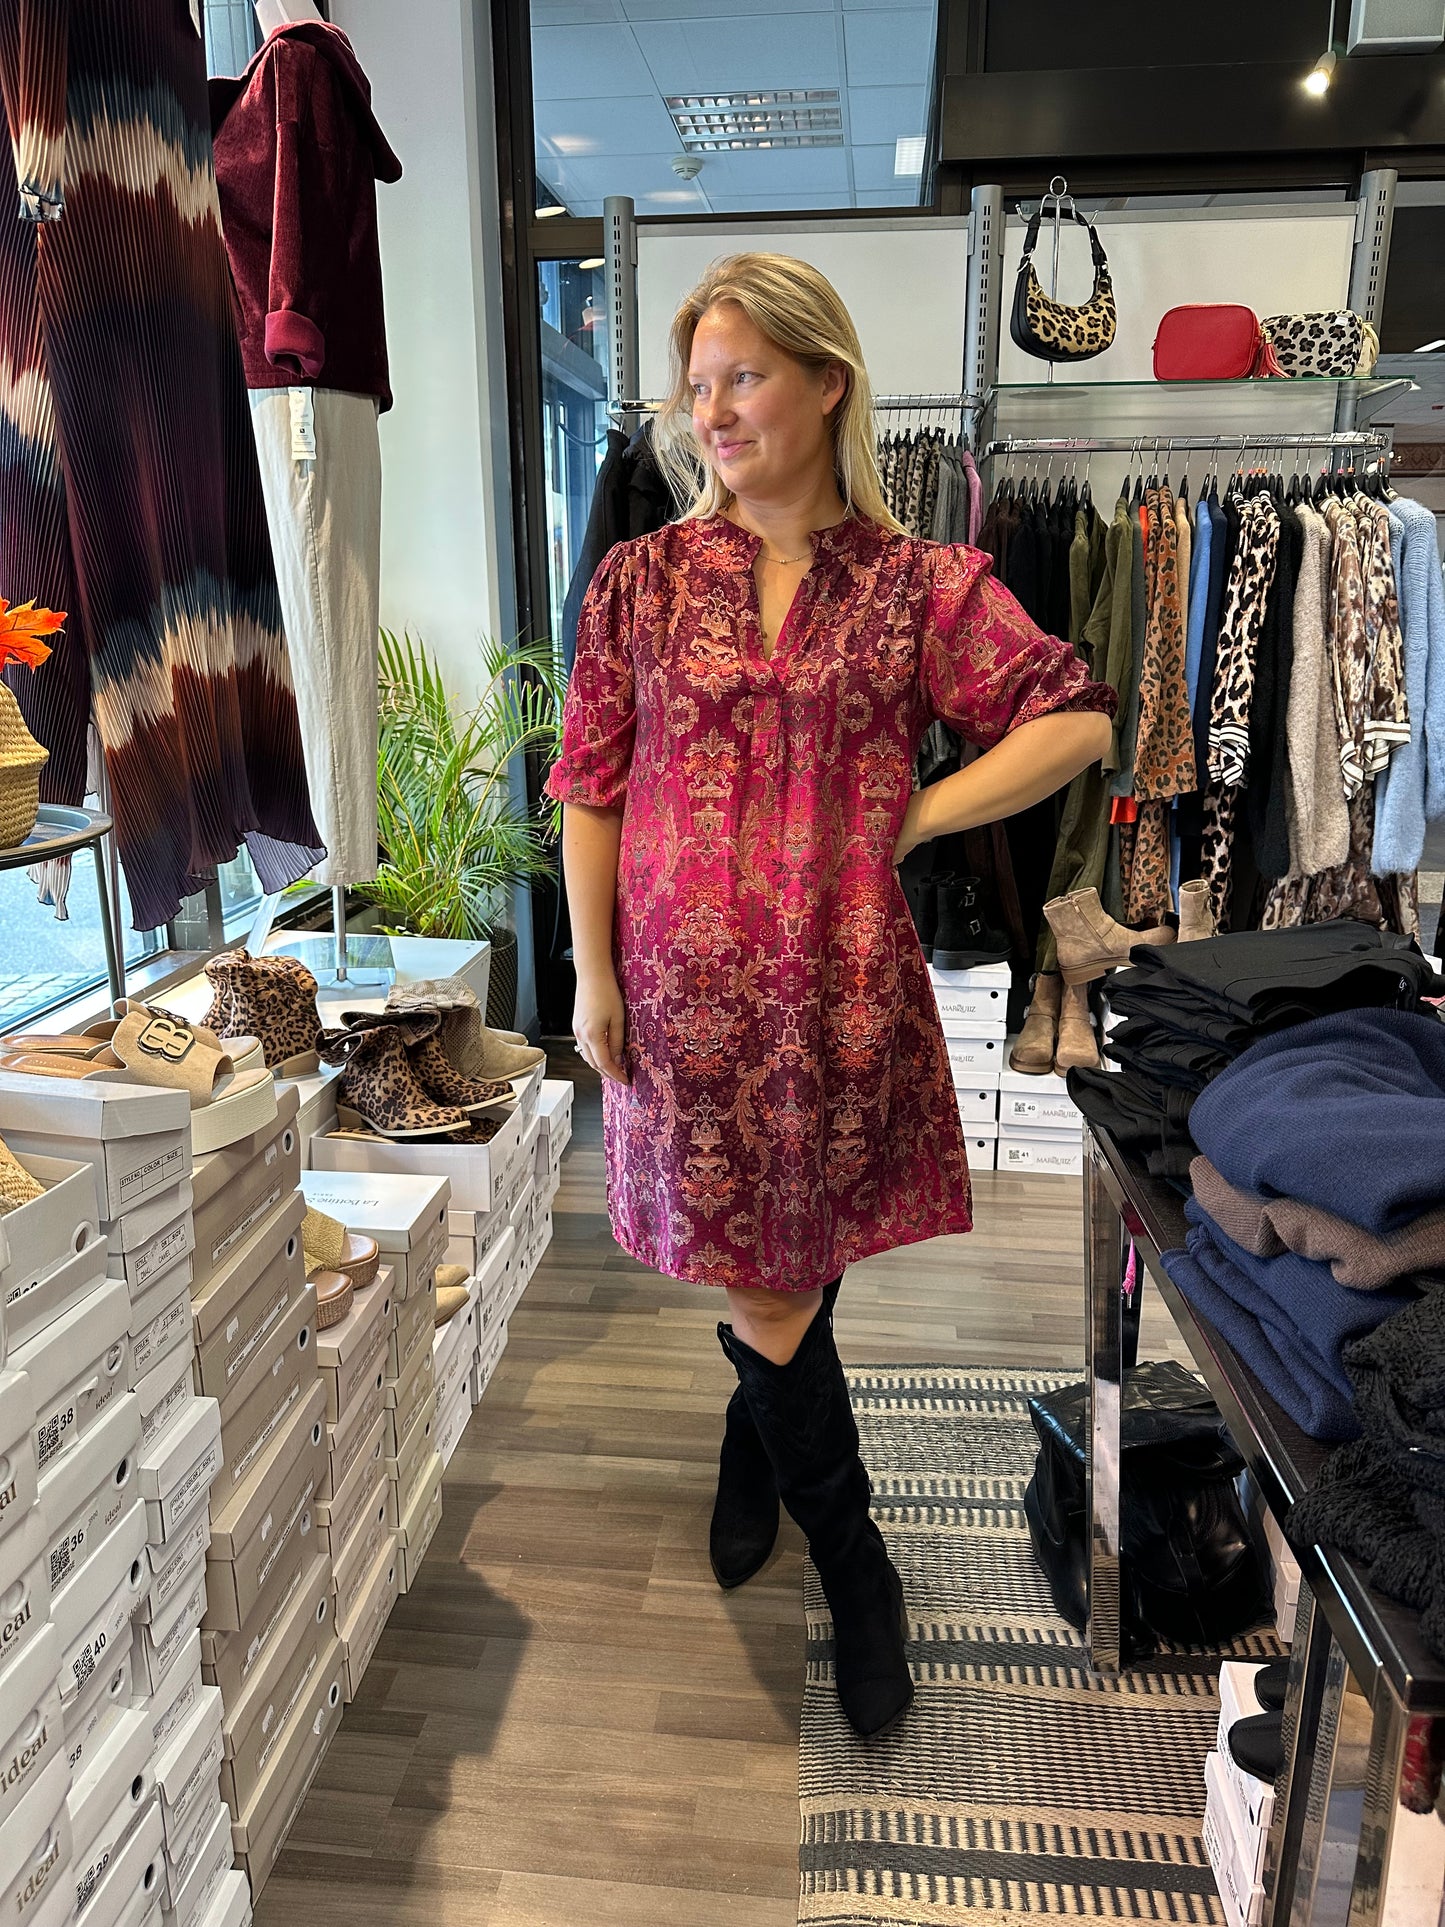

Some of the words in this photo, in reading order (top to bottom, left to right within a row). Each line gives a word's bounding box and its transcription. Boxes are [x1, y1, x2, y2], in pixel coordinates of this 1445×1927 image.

[143, 1160, 160, 1173] COLOR
[166, 1151, 178, 1160] SIZE
[121, 1175, 134, 1186] STYLE
[95, 1386, 114, 1410] ideal
[59, 1407, 74, 1431] 38
[104, 1500, 122, 1525] ideal
[71, 1529, 84, 1552] 36
[0, 1601, 32, 1651] eal
[94, 1632, 107, 1657] 40
[0, 1725, 48, 1794] ideal
[69, 1744, 82, 1770] 38
[15, 1838, 61, 1914] ideal
